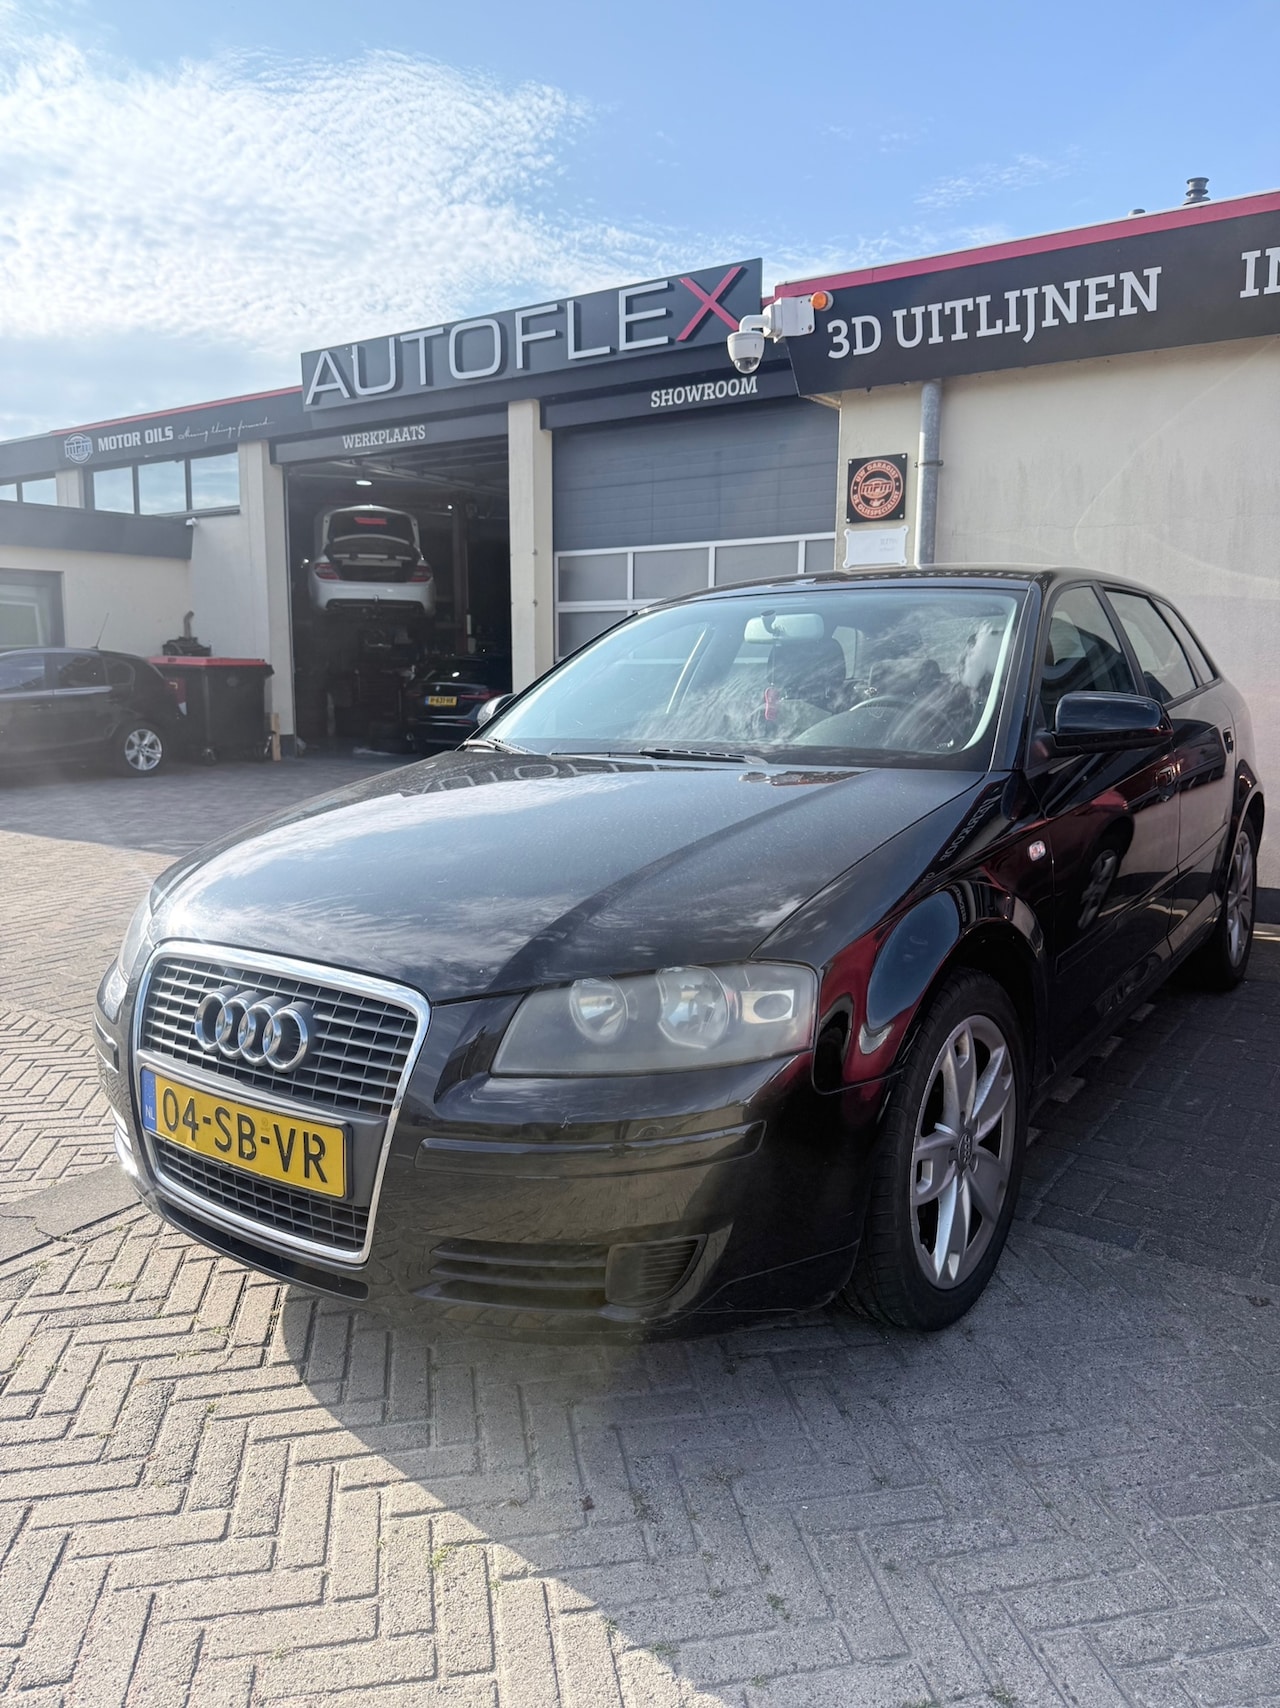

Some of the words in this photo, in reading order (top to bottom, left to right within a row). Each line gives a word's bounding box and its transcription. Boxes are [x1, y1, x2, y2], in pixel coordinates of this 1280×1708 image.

[827, 315, 882, 359] 3D
[893, 266, 1162, 349] UITLIJNEN
[305, 266, 743, 405] AUTOFLEX
[650, 375, 758, 408] SHOWROOM
[98, 431, 141, 452] MOTOR
[145, 426, 174, 444] OILS
[342, 425, 426, 450] WERKPLAATS
[867, 462, 898, 479] GARAGIST
[145, 1104, 155, 1120] NL
[162, 1087, 328, 1183] 04-SB-VR
